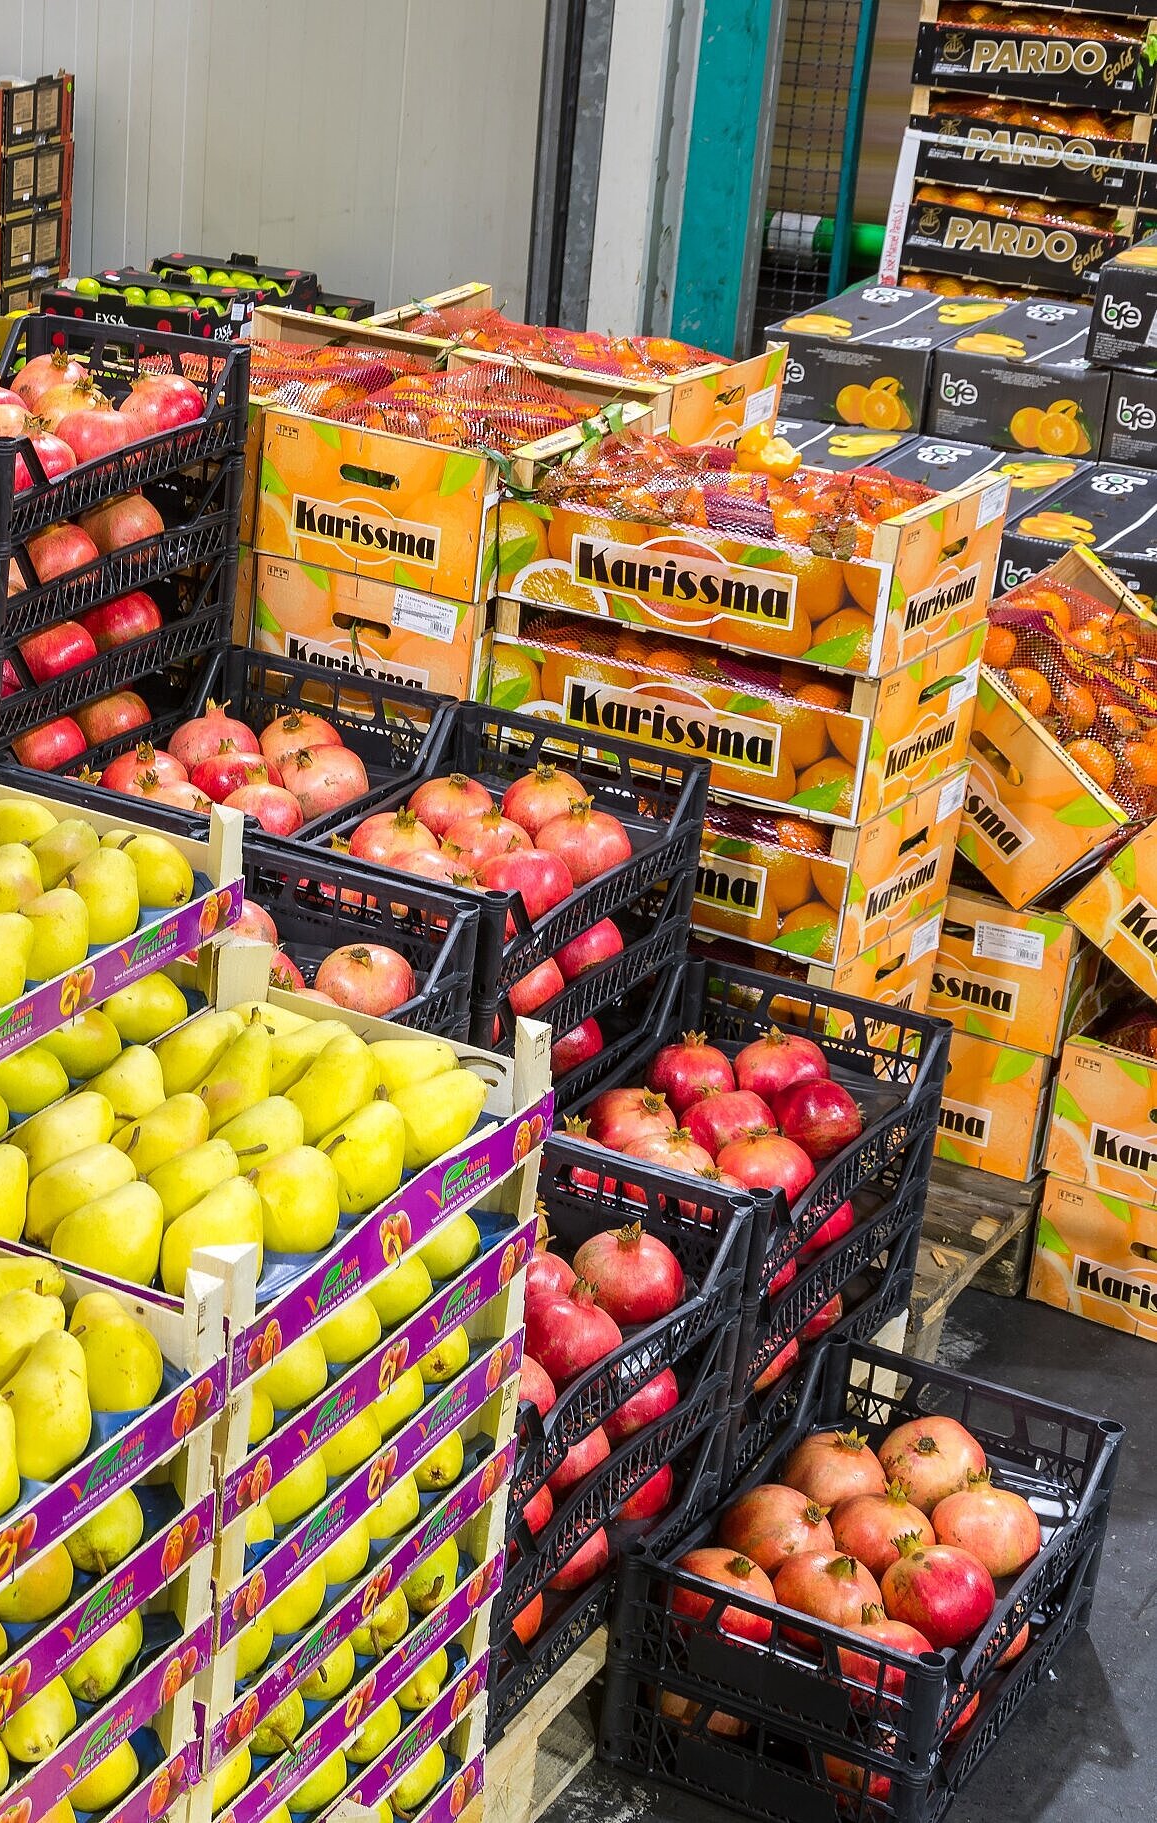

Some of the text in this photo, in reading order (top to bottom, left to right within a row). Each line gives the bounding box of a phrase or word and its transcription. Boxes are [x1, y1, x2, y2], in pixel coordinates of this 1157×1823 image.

[970, 40, 1107, 75] PARDO
[1103, 45, 1135, 87] Gold
[963, 128, 1096, 171] PARDO
[942, 216, 1077, 263] PARDO
[1071, 239, 1105, 276] Gold
[295, 498, 437, 562] Karissma
[578, 542, 790, 620] Karissma
[904, 575, 977, 633] Karissma
[569, 684, 774, 768] Karissma
[884, 719, 954, 780] Karissma
[865, 858, 939, 922] Karissma
[466, 1153, 490, 1174] TARIM
